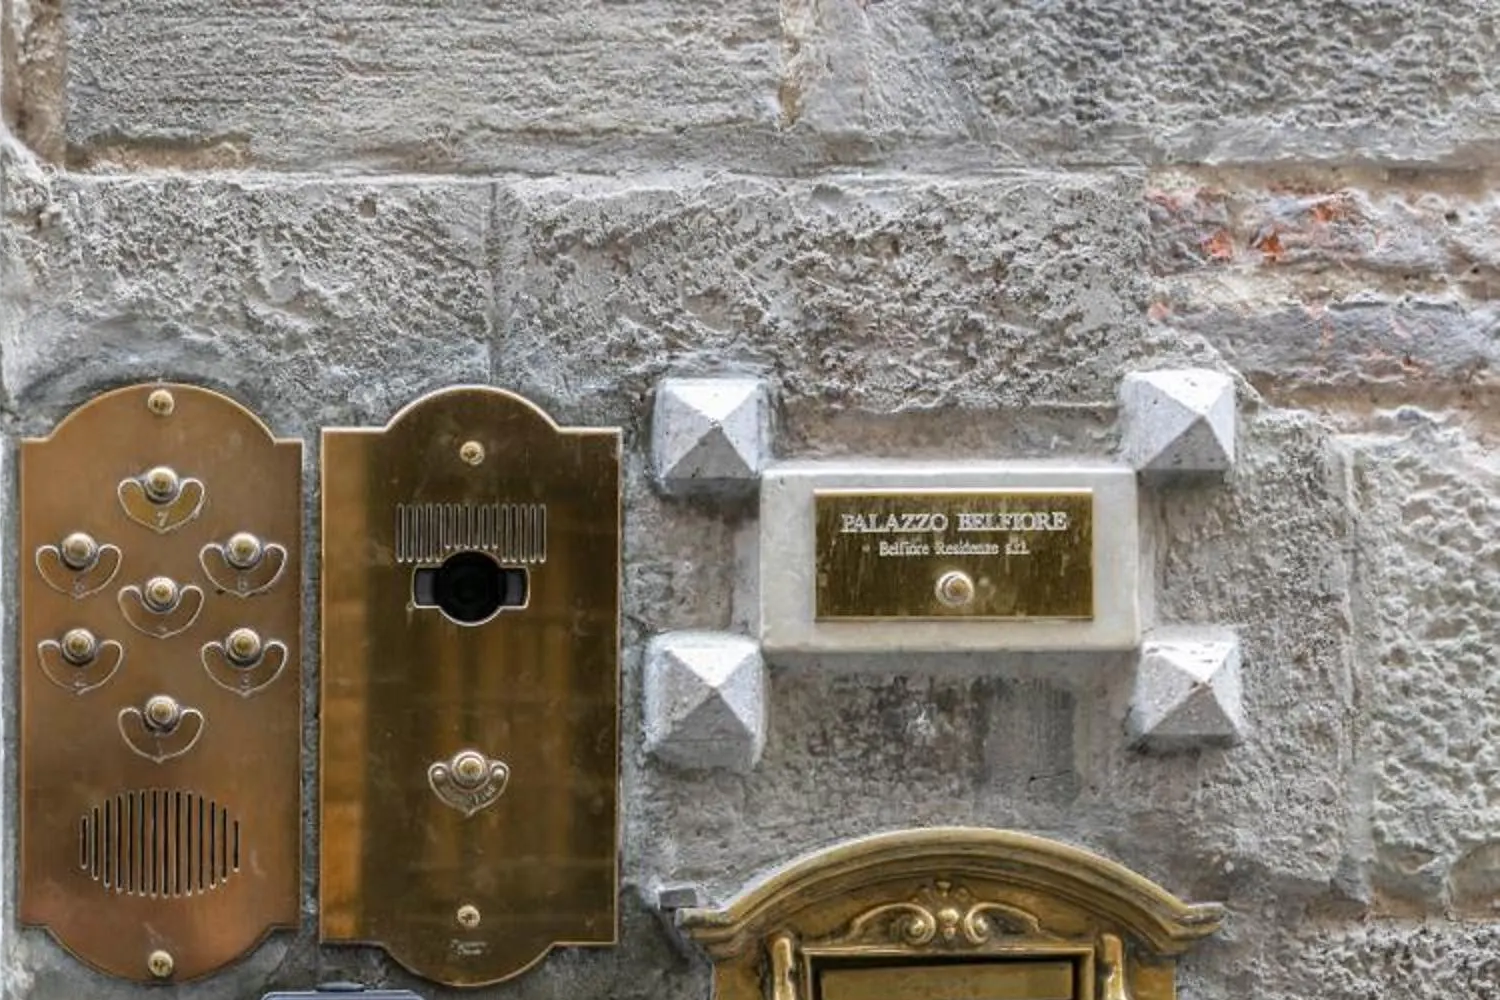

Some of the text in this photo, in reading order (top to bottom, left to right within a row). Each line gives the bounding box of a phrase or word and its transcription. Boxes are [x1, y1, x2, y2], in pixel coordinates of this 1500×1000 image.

[156, 510, 170, 527] 7
[840, 511, 1068, 533] PALAZZO BELFIORE
[879, 540, 930, 557] Belfiore
